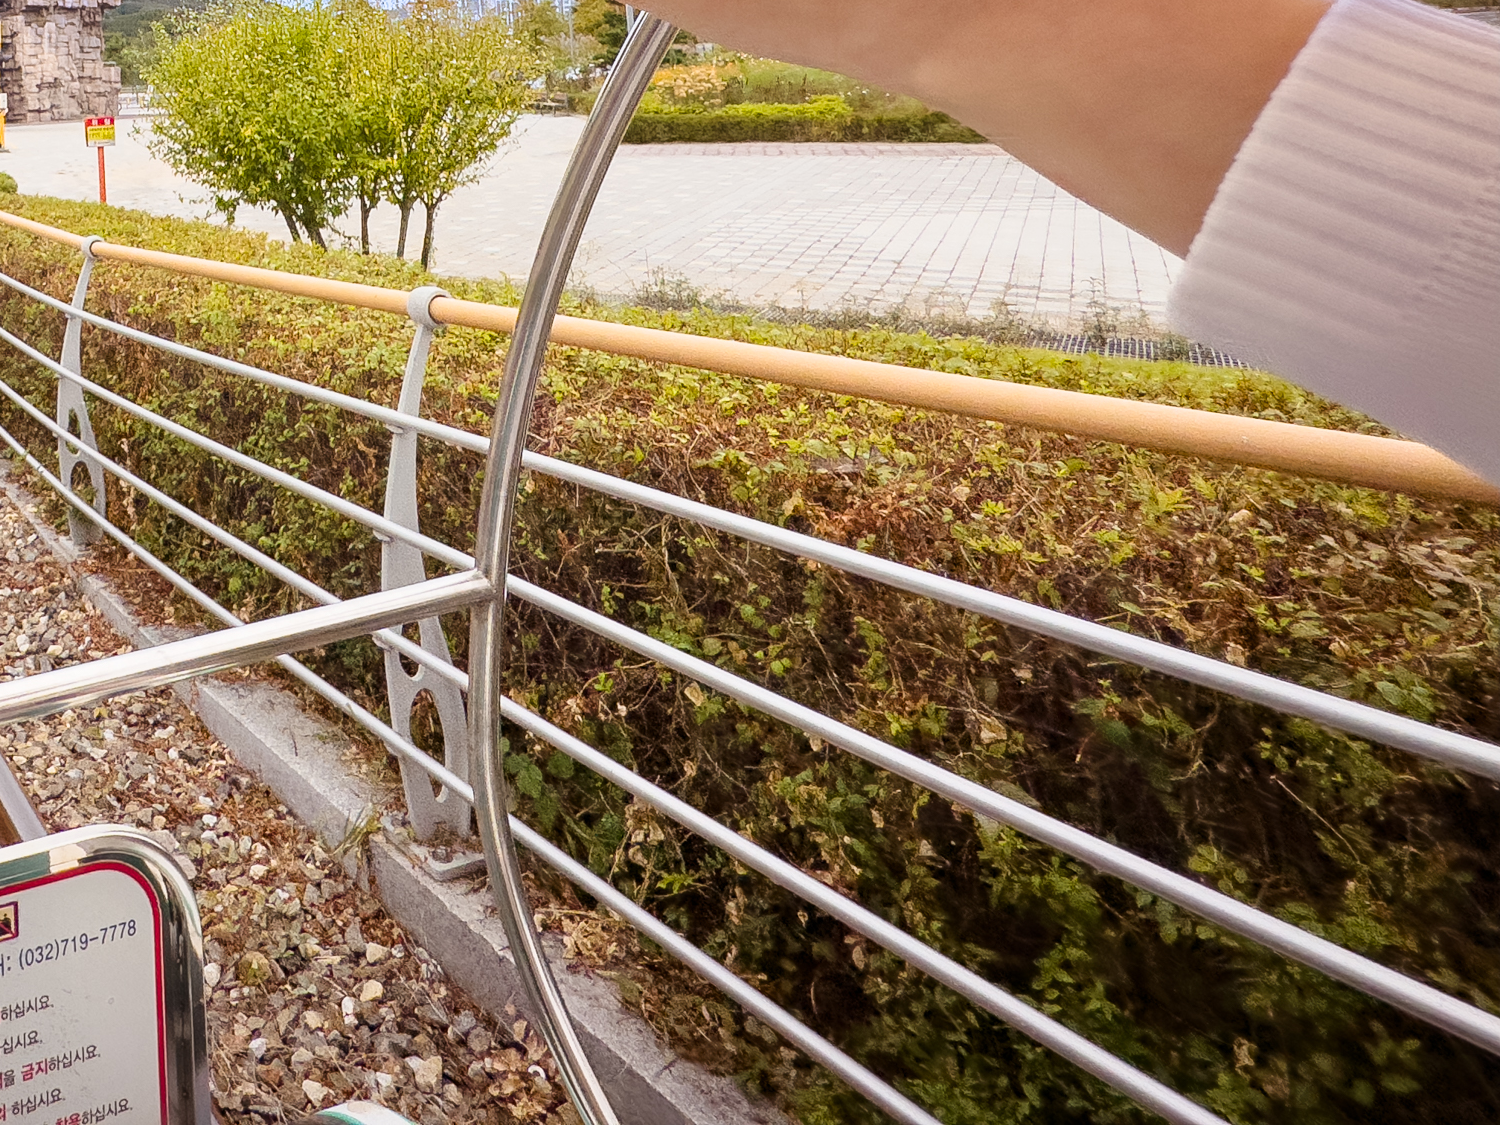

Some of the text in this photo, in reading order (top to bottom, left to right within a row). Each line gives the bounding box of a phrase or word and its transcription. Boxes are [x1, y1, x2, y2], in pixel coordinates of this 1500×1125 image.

[18, 919, 137, 970] (032)719-7778
[20, 1044, 101, 1082] 금지하십시요.
[11, 1088, 66, 1116] 하십시요.
